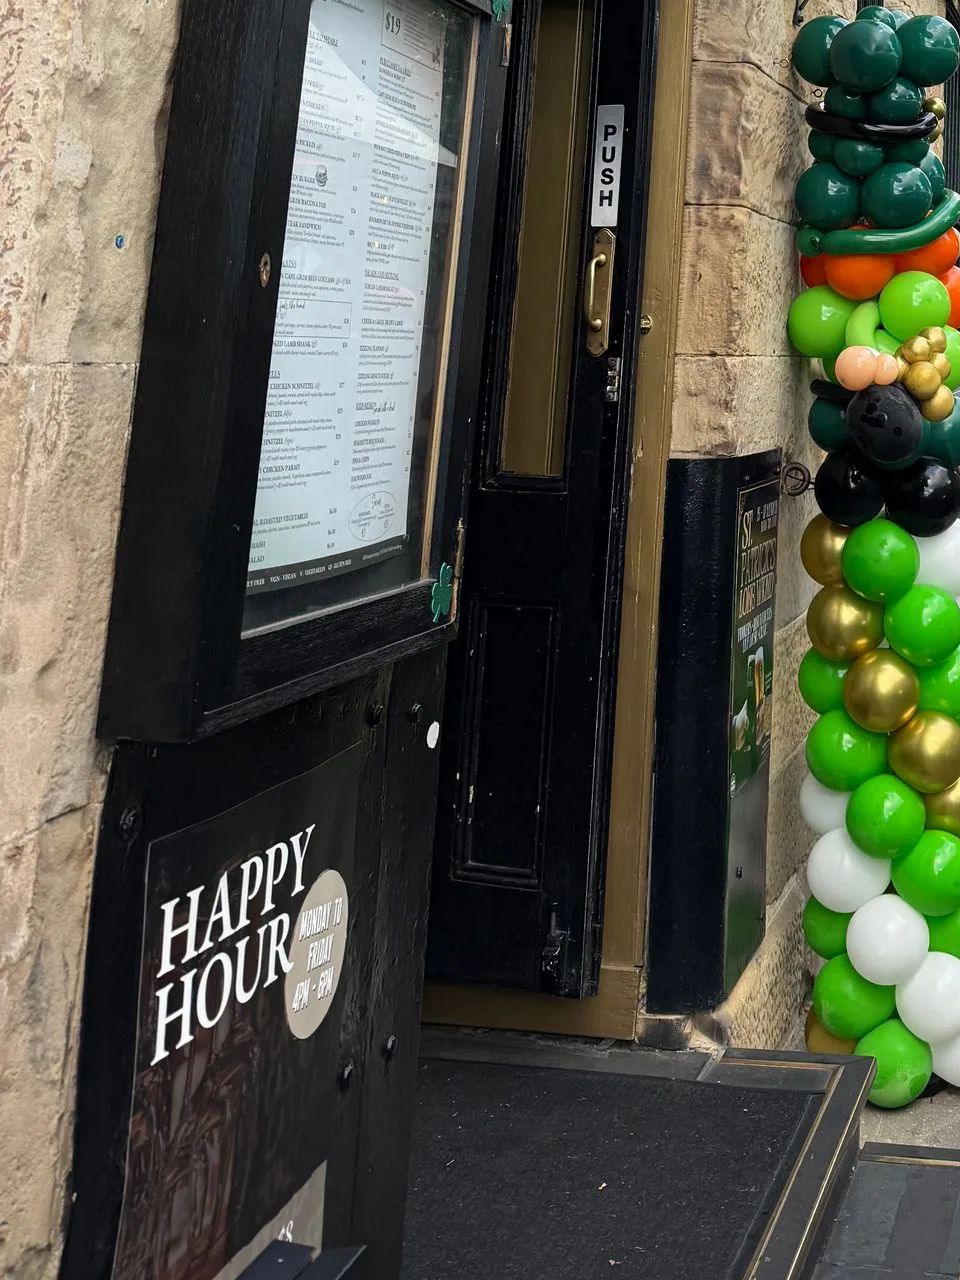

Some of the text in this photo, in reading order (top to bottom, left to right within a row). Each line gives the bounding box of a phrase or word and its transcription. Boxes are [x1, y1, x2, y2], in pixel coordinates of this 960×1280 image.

[385, 11, 401, 35] $19
[599, 124, 617, 207] PUSH
[155, 823, 317, 979] HAPPY
[299, 896, 343, 942] MONDAY TO
[307, 932, 334, 973] FRIDAY
[150, 912, 295, 1067] HOUR
